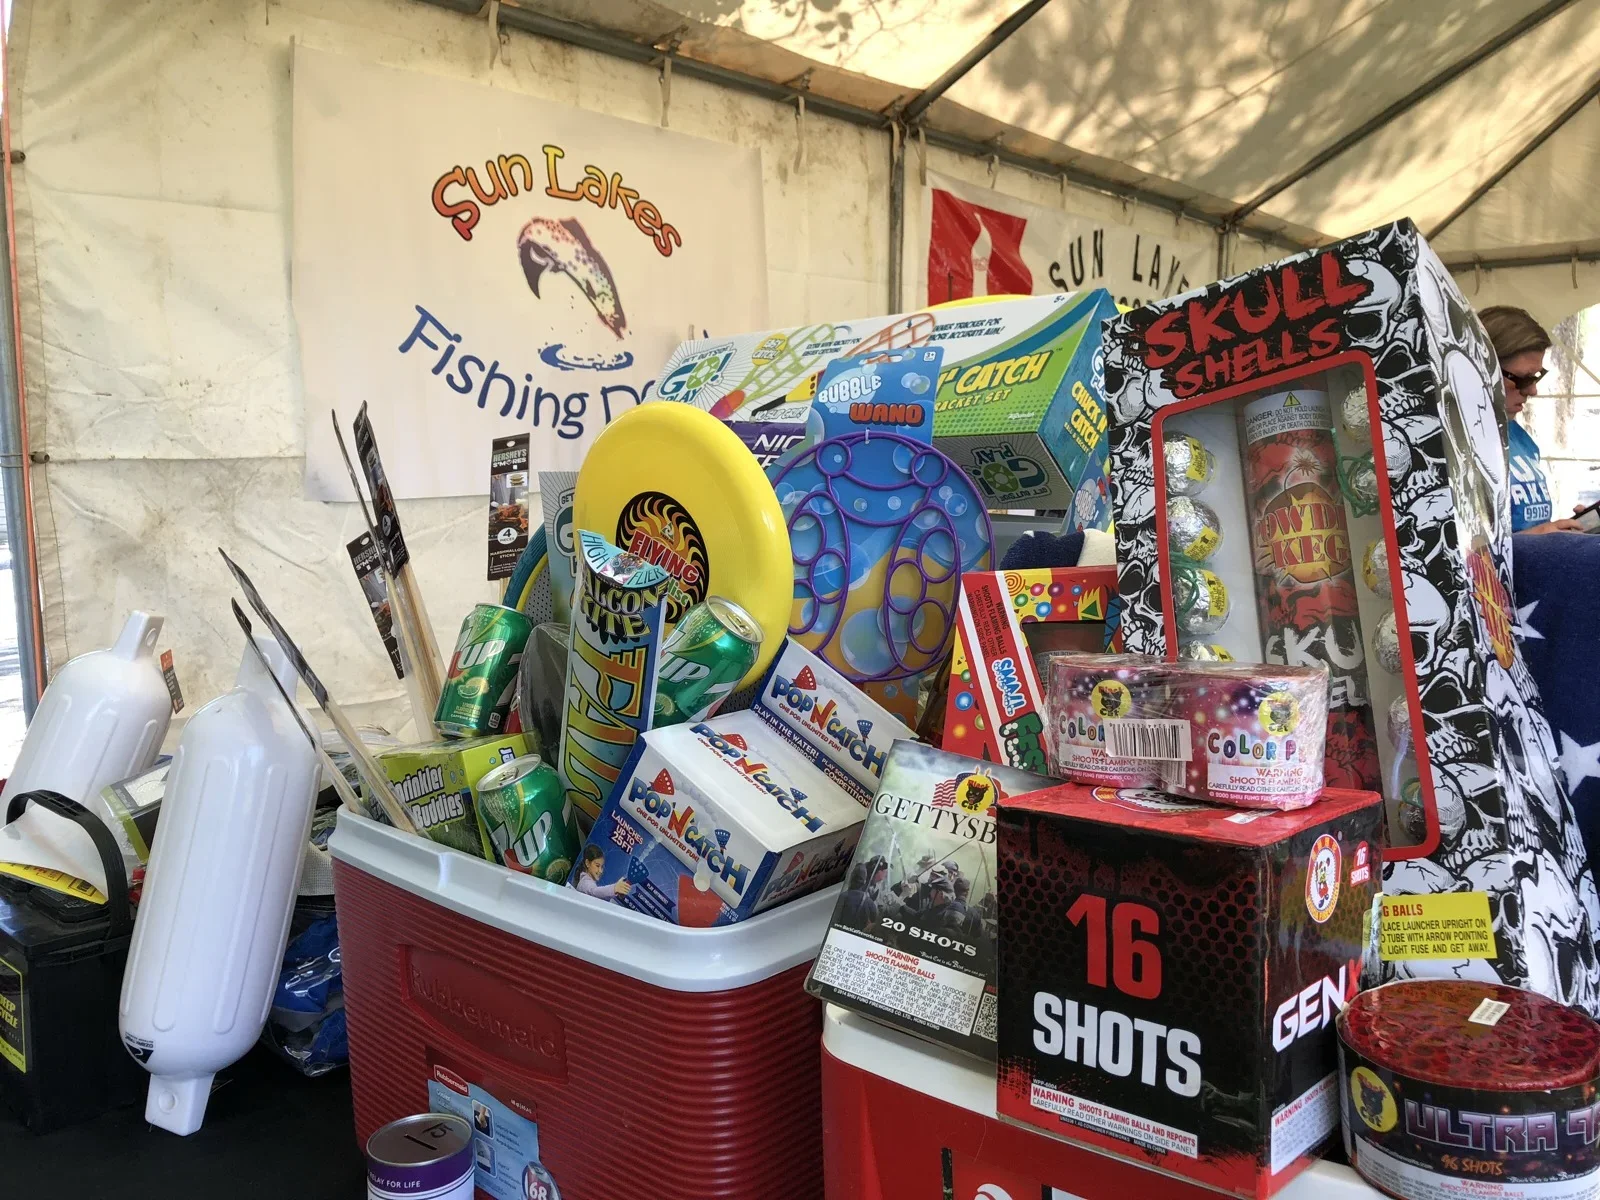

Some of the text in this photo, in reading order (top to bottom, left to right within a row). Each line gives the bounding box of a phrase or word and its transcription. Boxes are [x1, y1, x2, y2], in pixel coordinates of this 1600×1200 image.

[432, 145, 682, 257] Sun Lakes
[1048, 229, 1104, 293] SUN
[1144, 251, 1367, 368] SKULL
[398, 304, 590, 440] Fishing
[1175, 318, 1340, 397] SHELLS
[955, 351, 1051, 394] CATCH
[818, 375, 882, 403] BUBBLE
[984, 389, 1011, 404] SET
[1071, 381, 1101, 424] CHUCK
[850, 403, 923, 426] WAND
[1071, 408, 1100, 449] CATCH
[493, 449, 527, 462] HERSHEY'S
[976, 445, 1015, 464] PLAY
[1526, 505, 1549, 519] 99115
[582, 534, 610, 570] HIGH
[628, 530, 700, 583] FLYING
[1271, 532, 1350, 569] KEG
[627, 567, 664, 585] FLIER
[974, 589, 997, 657] CAREFULLY READ OTHER
[982, 585, 1007, 655] SHOOTS FLAMING BALLS
[996, 602, 1009, 630] WARNING
[754, 704, 819, 759] PLAY THE WATER!
[770, 675, 814, 714] POP
[826, 718, 888, 779] CATCH
[779, 703, 842, 752] ONE UNLIMITED FUN!
[1072, 755, 1134, 766] SHOOTS FLAMING
[1208, 732, 1277, 760] COLOR
[689, 723, 741, 758] POP
[752, 773, 826, 834] CATCH
[722, 758, 769, 795] UNLIMITED FUN!
[822, 758, 848, 781] PLAY SOLO
[967, 779, 990, 789] Black
[1229, 776, 1265, 785] SHOOTS
[1208, 782, 1255, 792] CAREFULLY READ
[410, 792, 464, 829] Buddies
[875, 792, 997, 844] GETTYSB
[961, 800, 980, 811] Cat
[611, 810, 644, 845] LAUNCHES
[616, 825, 635, 846] UP TO
[628, 776, 672, 819] POP
[684, 825, 751, 896] CATCH
[636, 807, 700, 862] ONE POP, UNLIMITED FUN!
[610, 831, 633, 855] 25FT!
[1356, 846, 1367, 866] 16
[1350, 866, 1369, 885] SHOTS
[1392, 903, 1424, 917] BALLS
[1402, 920, 1440, 931] LAUNCHER
[1441, 918, 1473, 930] UPRIGHT
[1475, 918, 1487, 928] ON
[881, 917, 977, 957] 20 SHOTS
[1065, 892, 1163, 1000] 16
[1387, 930, 1489, 943] TUBE WITH ARROW POINTING
[1388, 942, 1491, 955] LIGHT FUSE AND GET AWAY.
[865, 950, 936, 981] SHOOTS FLAMING BALLS
[886, 947, 920, 966] WARNING
[941, 984, 967, 996] OUTDOOR
[869, 1000, 940, 1031] FIREWORKS KONG
[1033, 991, 1201, 1098] SHOTS
[436, 1070, 468, 1093] Rubbermaid
[1033, 1086, 1075, 1107] WARNING
[1078, 1102, 1102, 1116] SHOOTS
[1104, 1110, 1130, 1126] FLAMING
[1131, 1119, 1151, 1133] BALLS
[1152, 1125, 1165, 1137] AND
[1167, 1131, 1196, 1147] REPORTS
[1033, 1097, 1066, 1115] CAREFULLY
[1067, 1107, 1084, 1120] READ
[1086, 1113, 1106, 1126] OTHER
[1107, 1120, 1143, 1138] WARNINGS
[1143, 1132, 1154, 1142] ON
[1155, 1136, 1170, 1147] SIDE
[1171, 1142, 1195, 1155] PANEL.
[1274, 1102, 1303, 1128] WARNING
[1404, 1097, 1558, 1154] ULTRA
[1441, 1154, 1503, 1176] 96 SHOTS
[387, 1178, 402, 1189] FOR
[404, 1180, 421, 1189] LIFE
[528, 1181, 548, 1200] 68
[1460, 1179, 1504, 1192] WARNING
